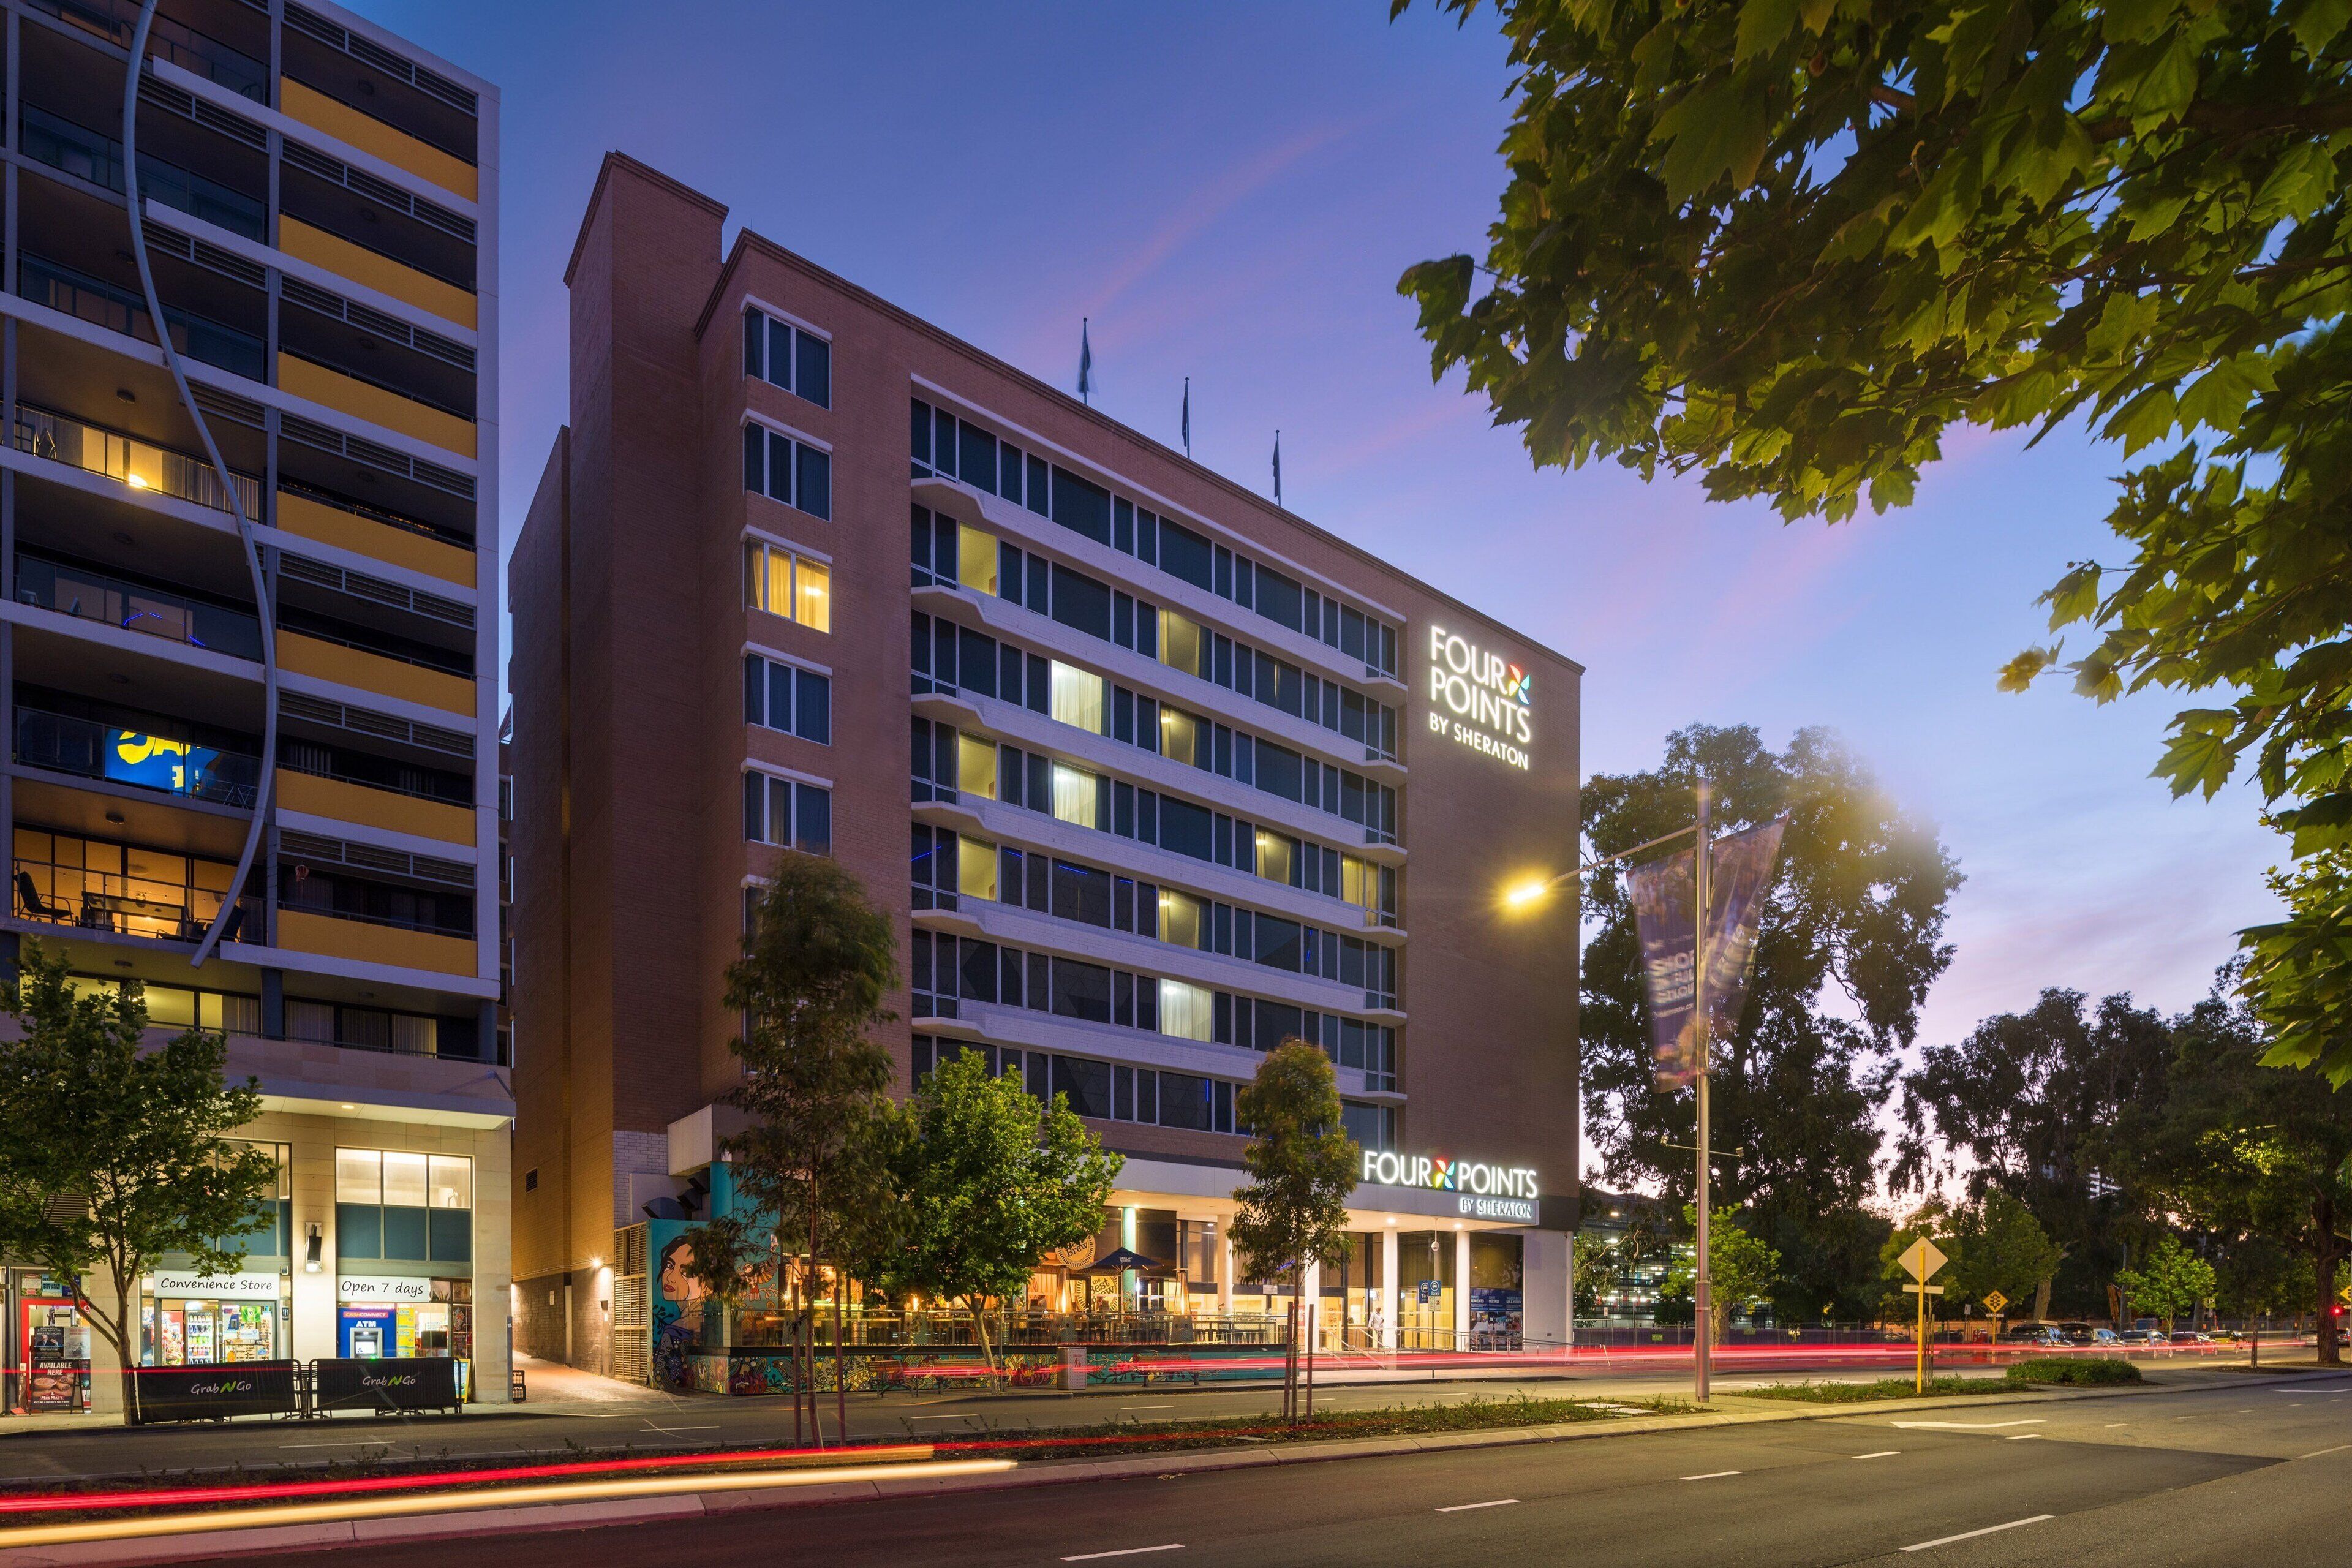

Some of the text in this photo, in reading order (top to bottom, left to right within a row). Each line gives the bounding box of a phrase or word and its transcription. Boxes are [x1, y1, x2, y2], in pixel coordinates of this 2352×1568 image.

[1431, 625, 1508, 696] FOUR
[1431, 666, 1531, 743] POINTS
[1429, 712, 1529, 771] BY SHERATON
[1364, 1151, 1537, 1199] FOUR POINTS
[1461, 1198, 1532, 1218] BY SHERATON
[1066, 1242, 1088, 1257] Brew
[160, 1278, 273, 1290] Convenience Store
[342, 1281, 424, 1298] Open 7 days
[190, 1384, 219, 1395] Grab
[236, 1381, 251, 1392] Go
[362, 1376, 387, 1387] Grab
[402, 1376, 416, 1385] Go
